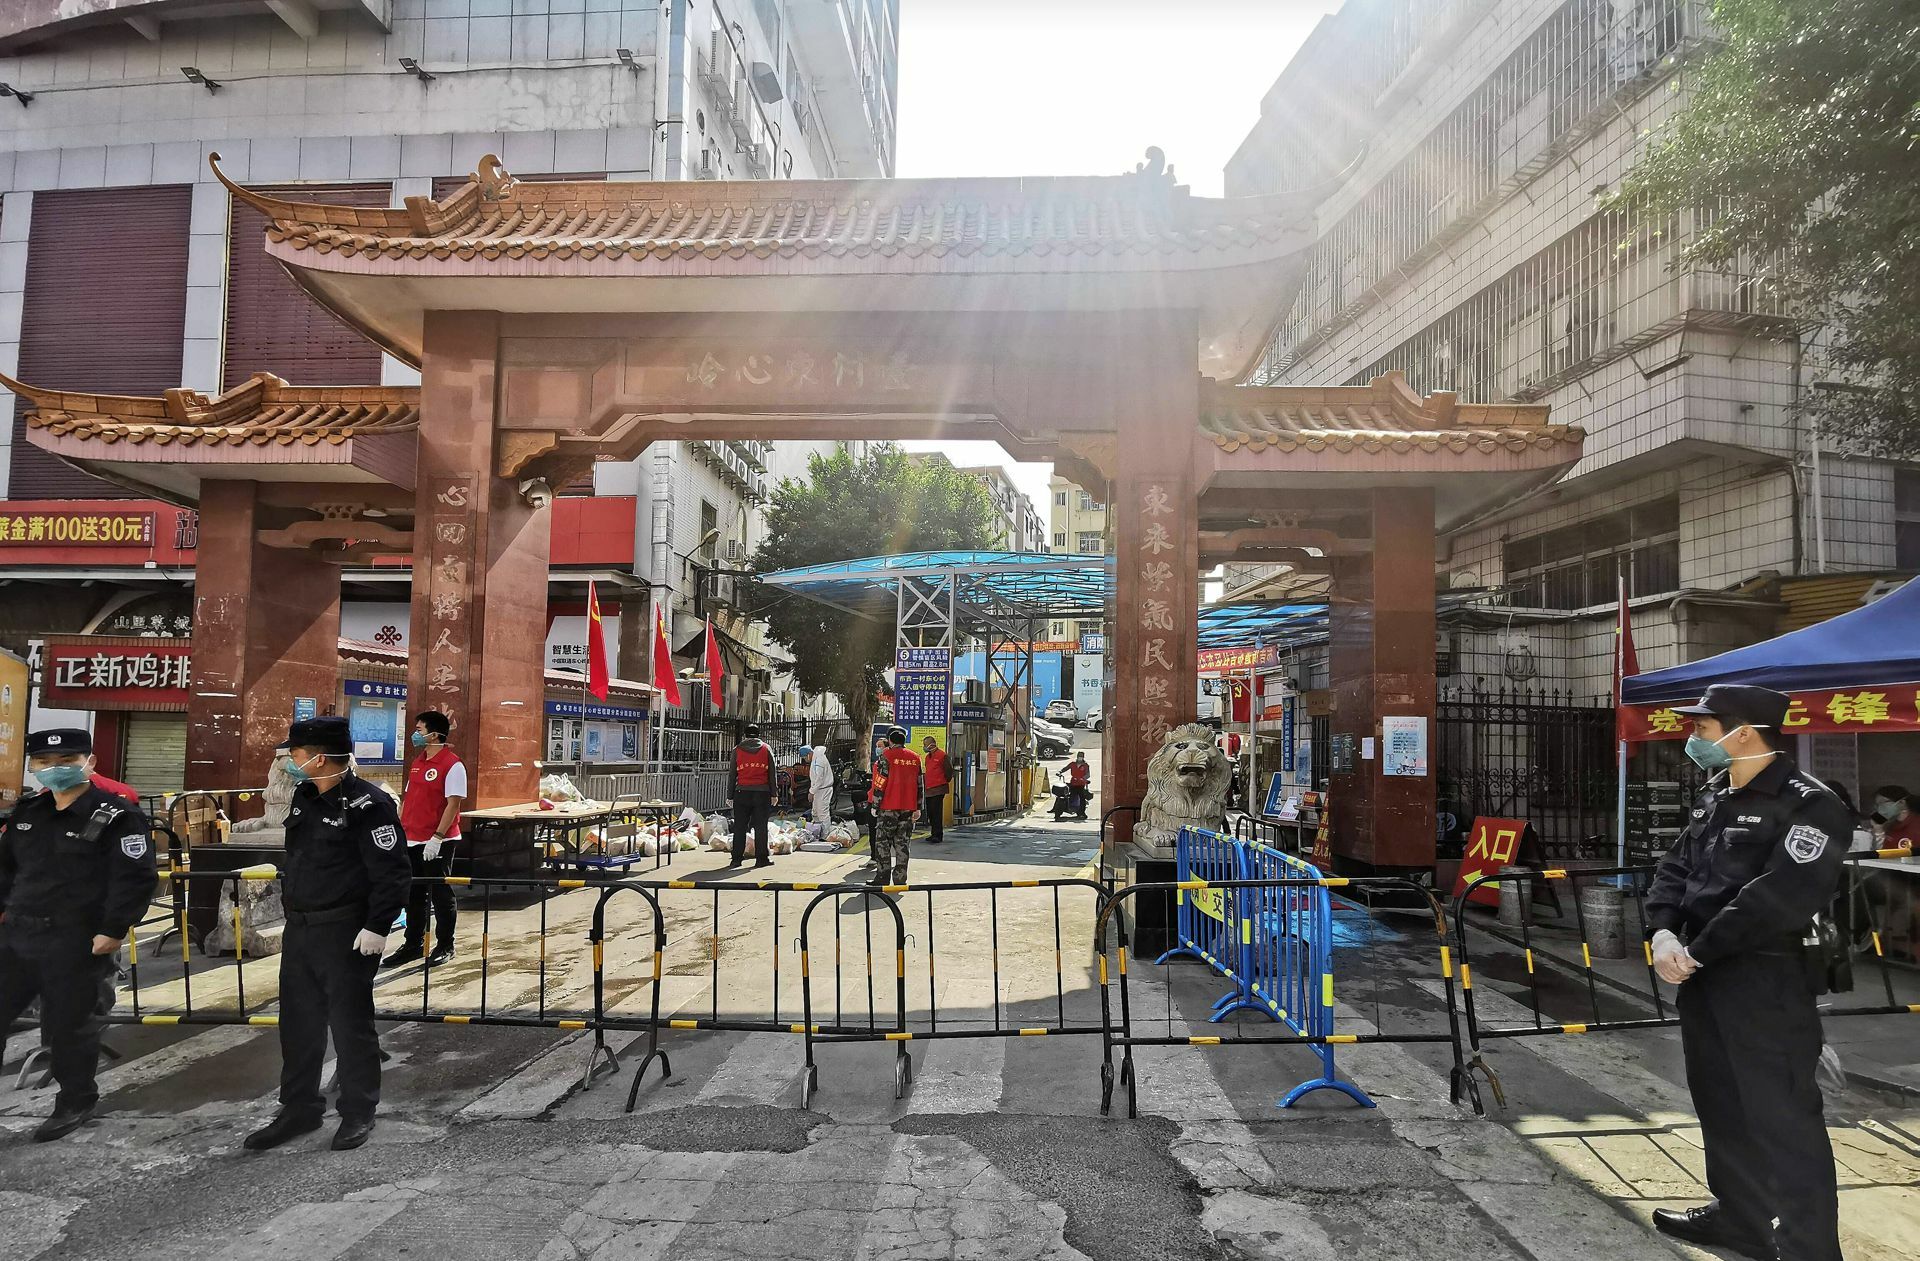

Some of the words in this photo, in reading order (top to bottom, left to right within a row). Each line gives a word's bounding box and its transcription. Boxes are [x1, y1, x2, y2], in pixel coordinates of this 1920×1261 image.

[55, 652, 191, 689] 正新鸡排
[899, 683, 946, 691] 无人值守停车场
[1468, 825, 1517, 863] 入口
